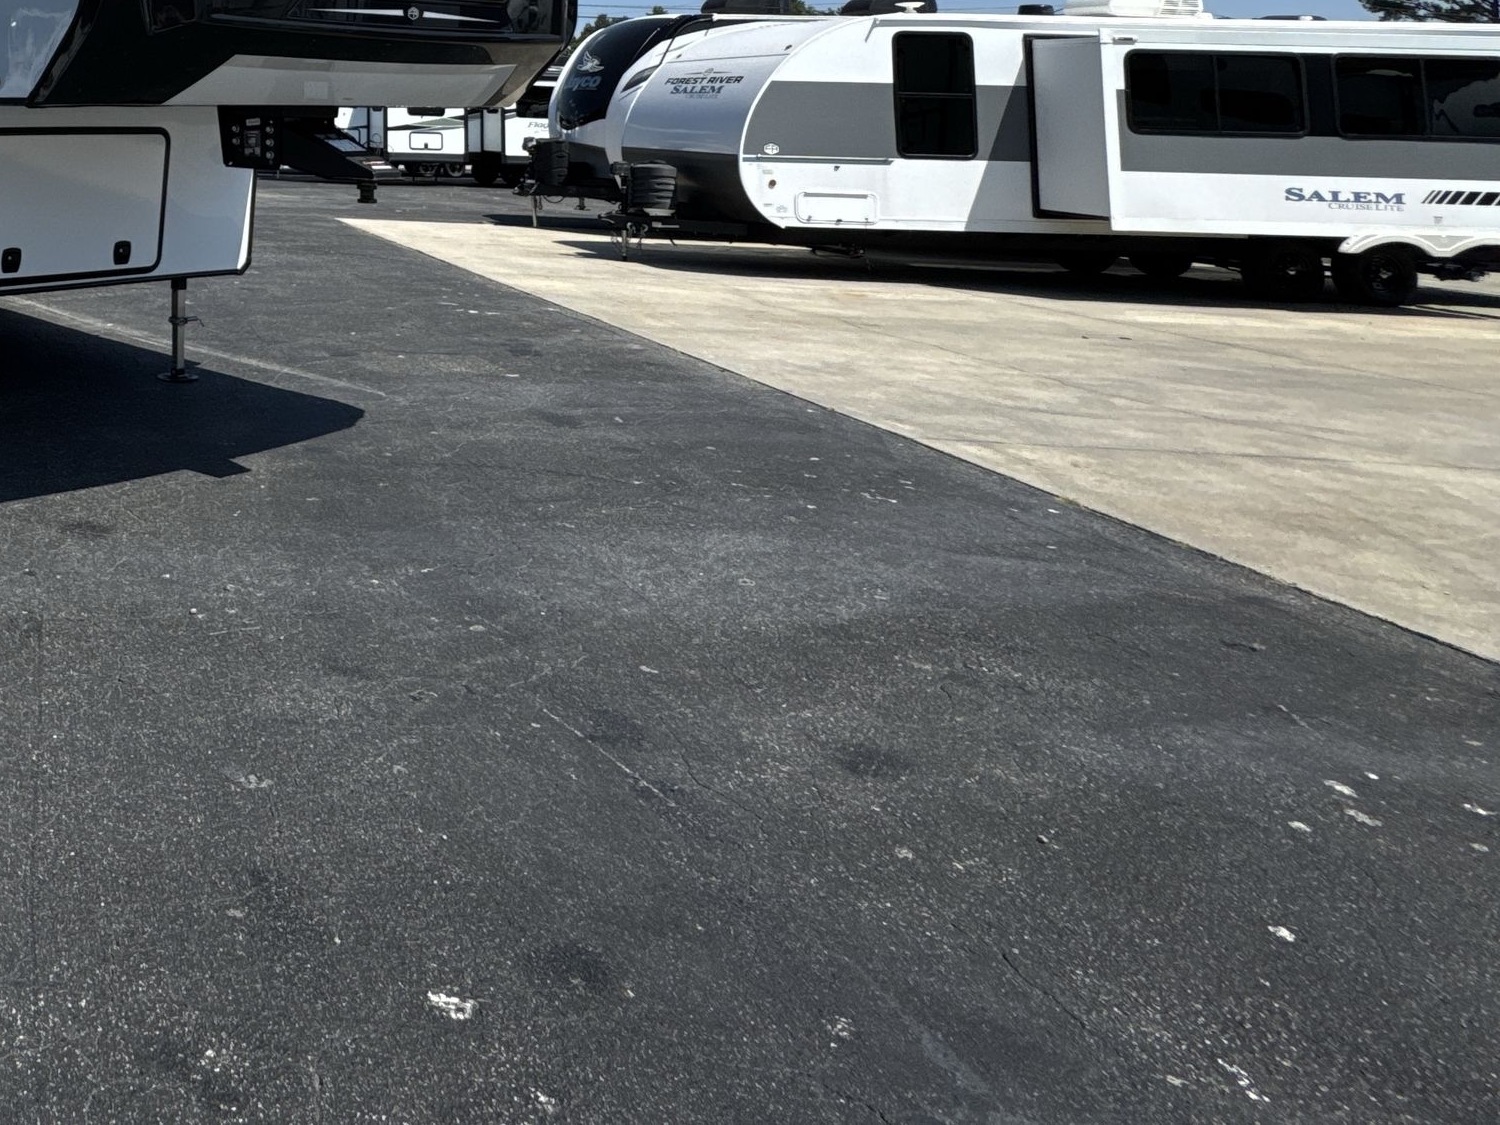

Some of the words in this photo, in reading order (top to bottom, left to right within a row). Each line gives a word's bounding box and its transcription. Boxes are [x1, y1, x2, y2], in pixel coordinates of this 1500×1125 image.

[665, 77, 706, 85] FOREST
[707, 76, 744, 84] RIVER
[670, 85, 725, 94] SALEM
[1285, 187, 1406, 205] SALEM
